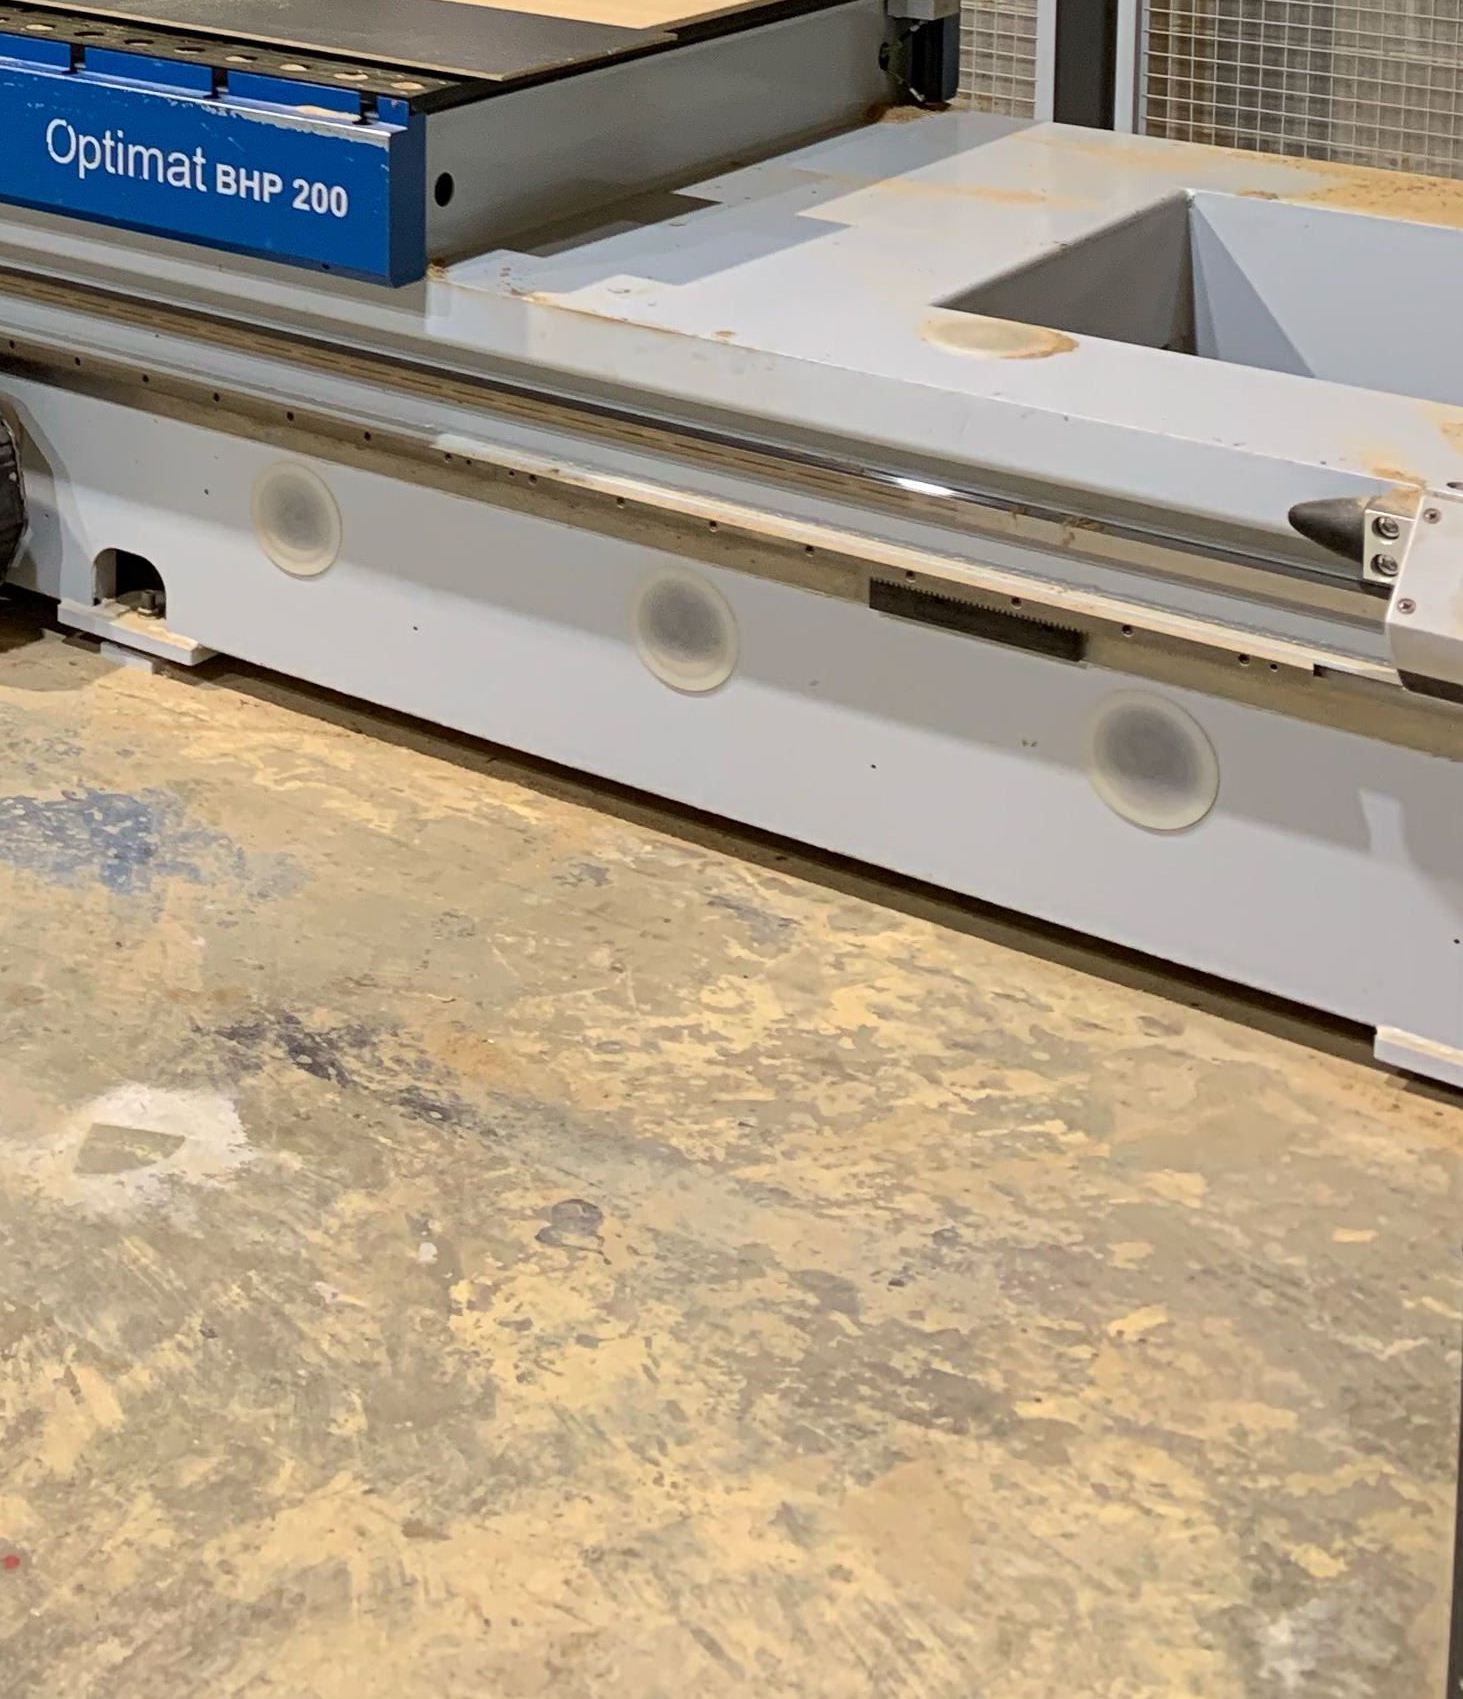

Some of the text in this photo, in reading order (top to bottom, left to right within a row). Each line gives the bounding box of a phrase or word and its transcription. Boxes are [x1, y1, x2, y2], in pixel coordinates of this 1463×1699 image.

[46, 118, 349, 218] Optimat BHP 200
